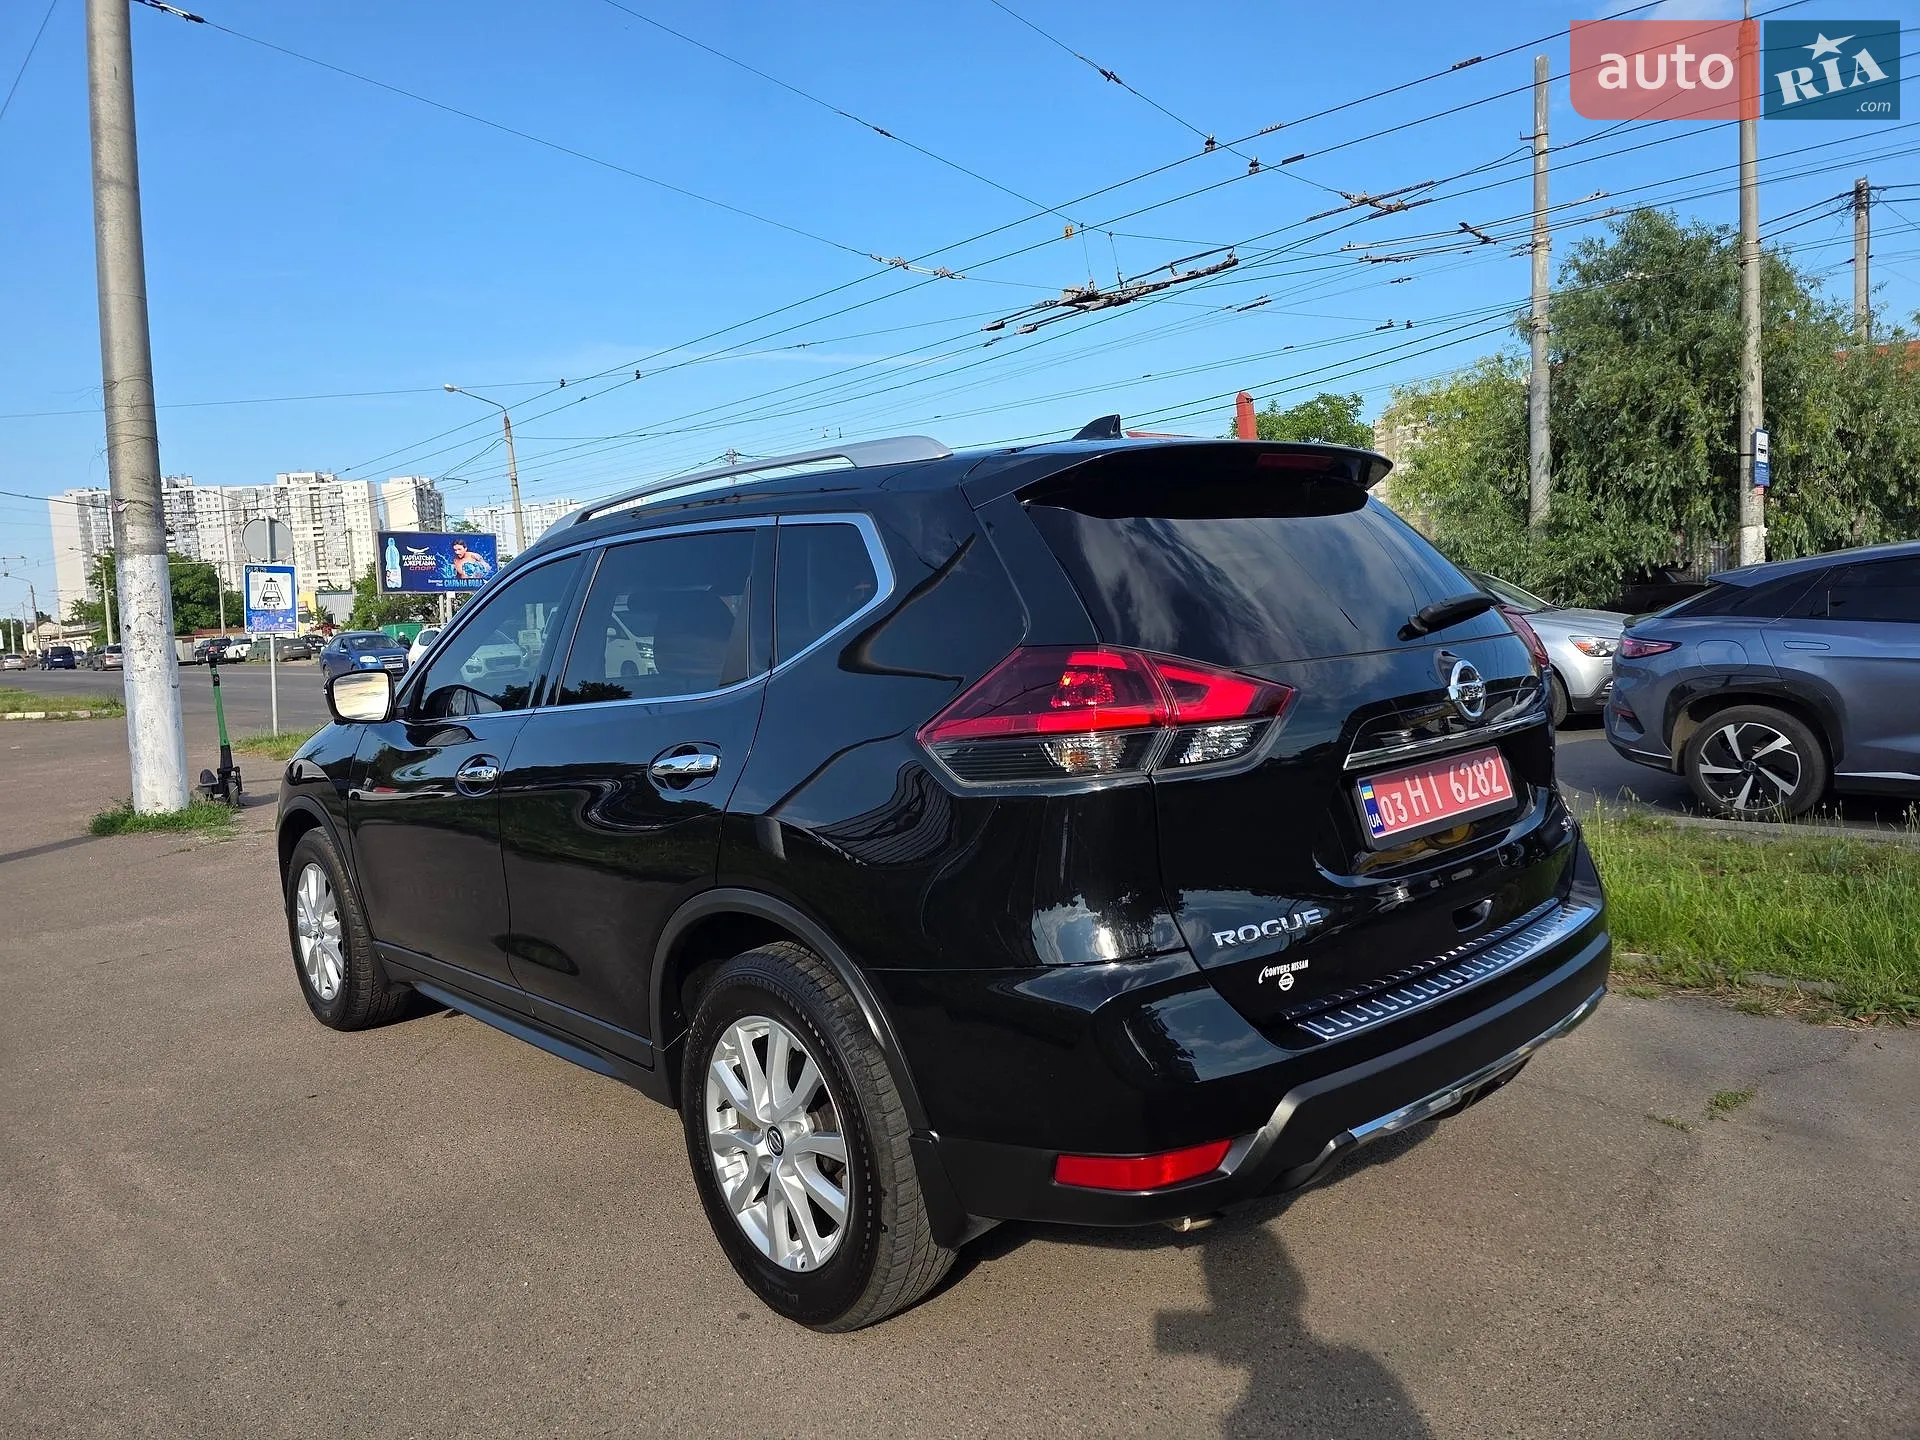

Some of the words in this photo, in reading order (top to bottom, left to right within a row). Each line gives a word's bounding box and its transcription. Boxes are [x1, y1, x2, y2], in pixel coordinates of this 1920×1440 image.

[1380, 792, 1409, 826] 03
[1449, 756, 1504, 804] 6282
[1368, 814, 1383, 828] UA
[1212, 908, 1324, 948] ROGUE
